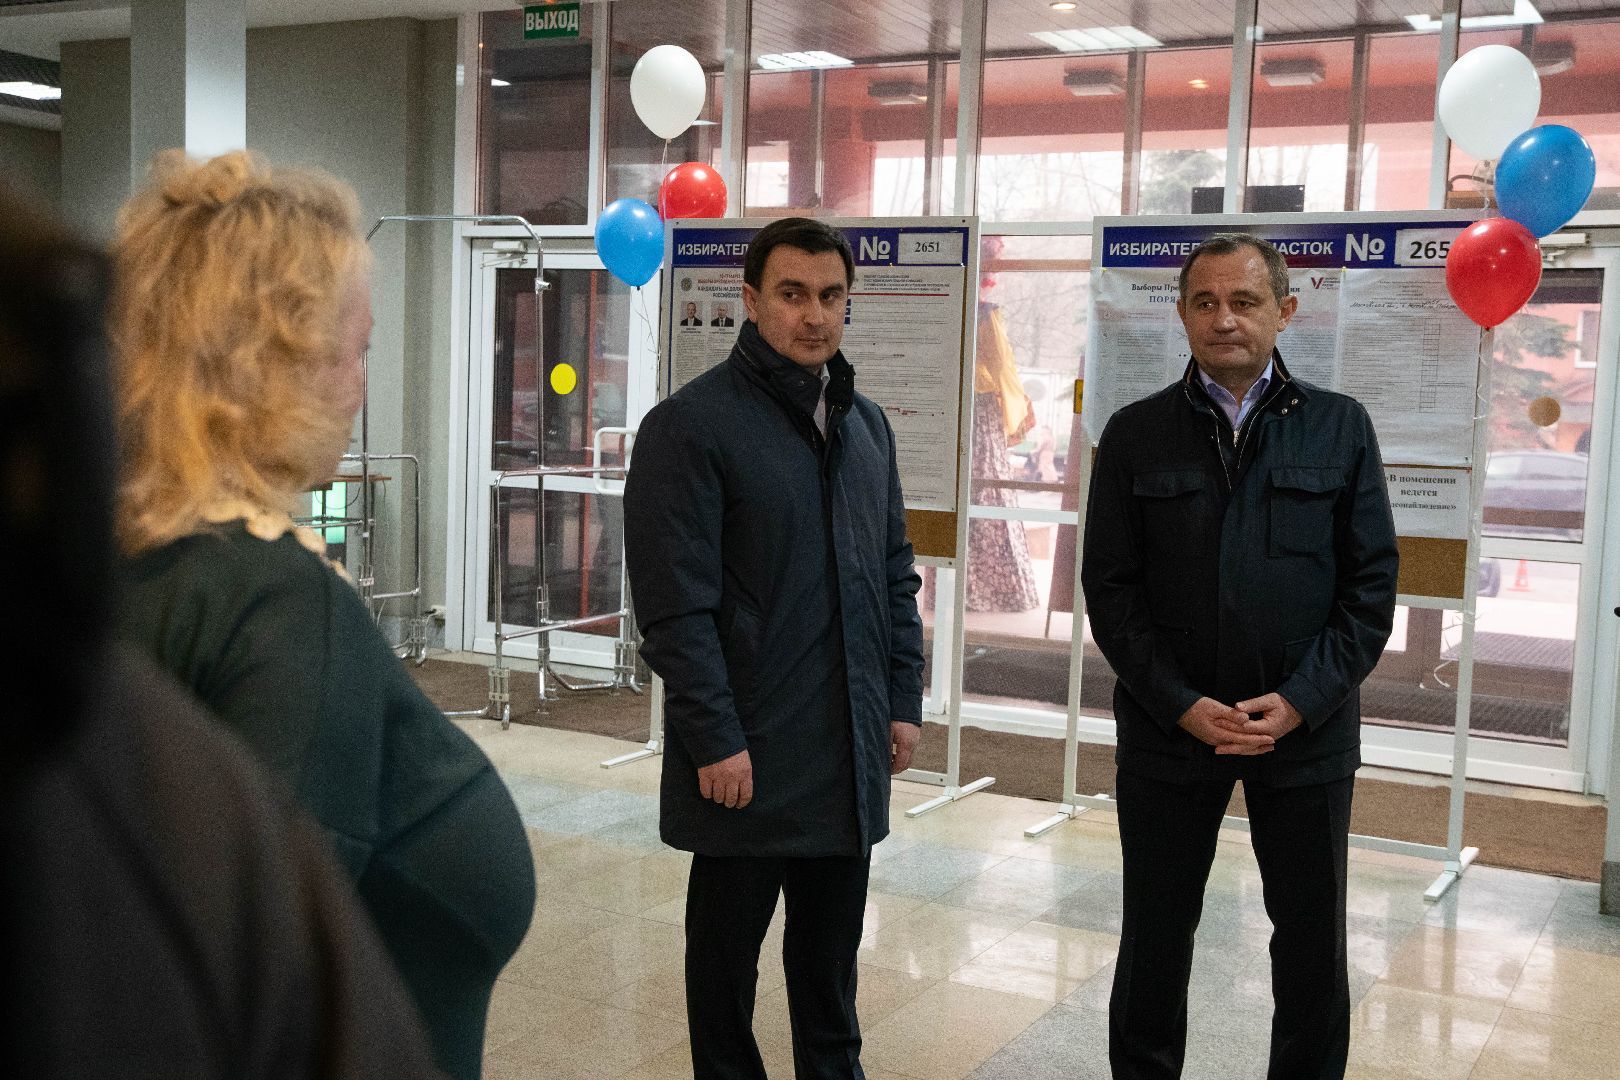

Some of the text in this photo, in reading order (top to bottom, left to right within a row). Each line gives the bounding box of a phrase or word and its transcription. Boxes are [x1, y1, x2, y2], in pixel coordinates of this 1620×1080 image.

[525, 9, 579, 31] ВЫХОД
[859, 235, 891, 261] №
[914, 241, 940, 253] 2651
[1344, 233, 1386, 262] №
[1131, 283, 1163, 293] Выборы
[1400, 489, 1438, 497] ведется
